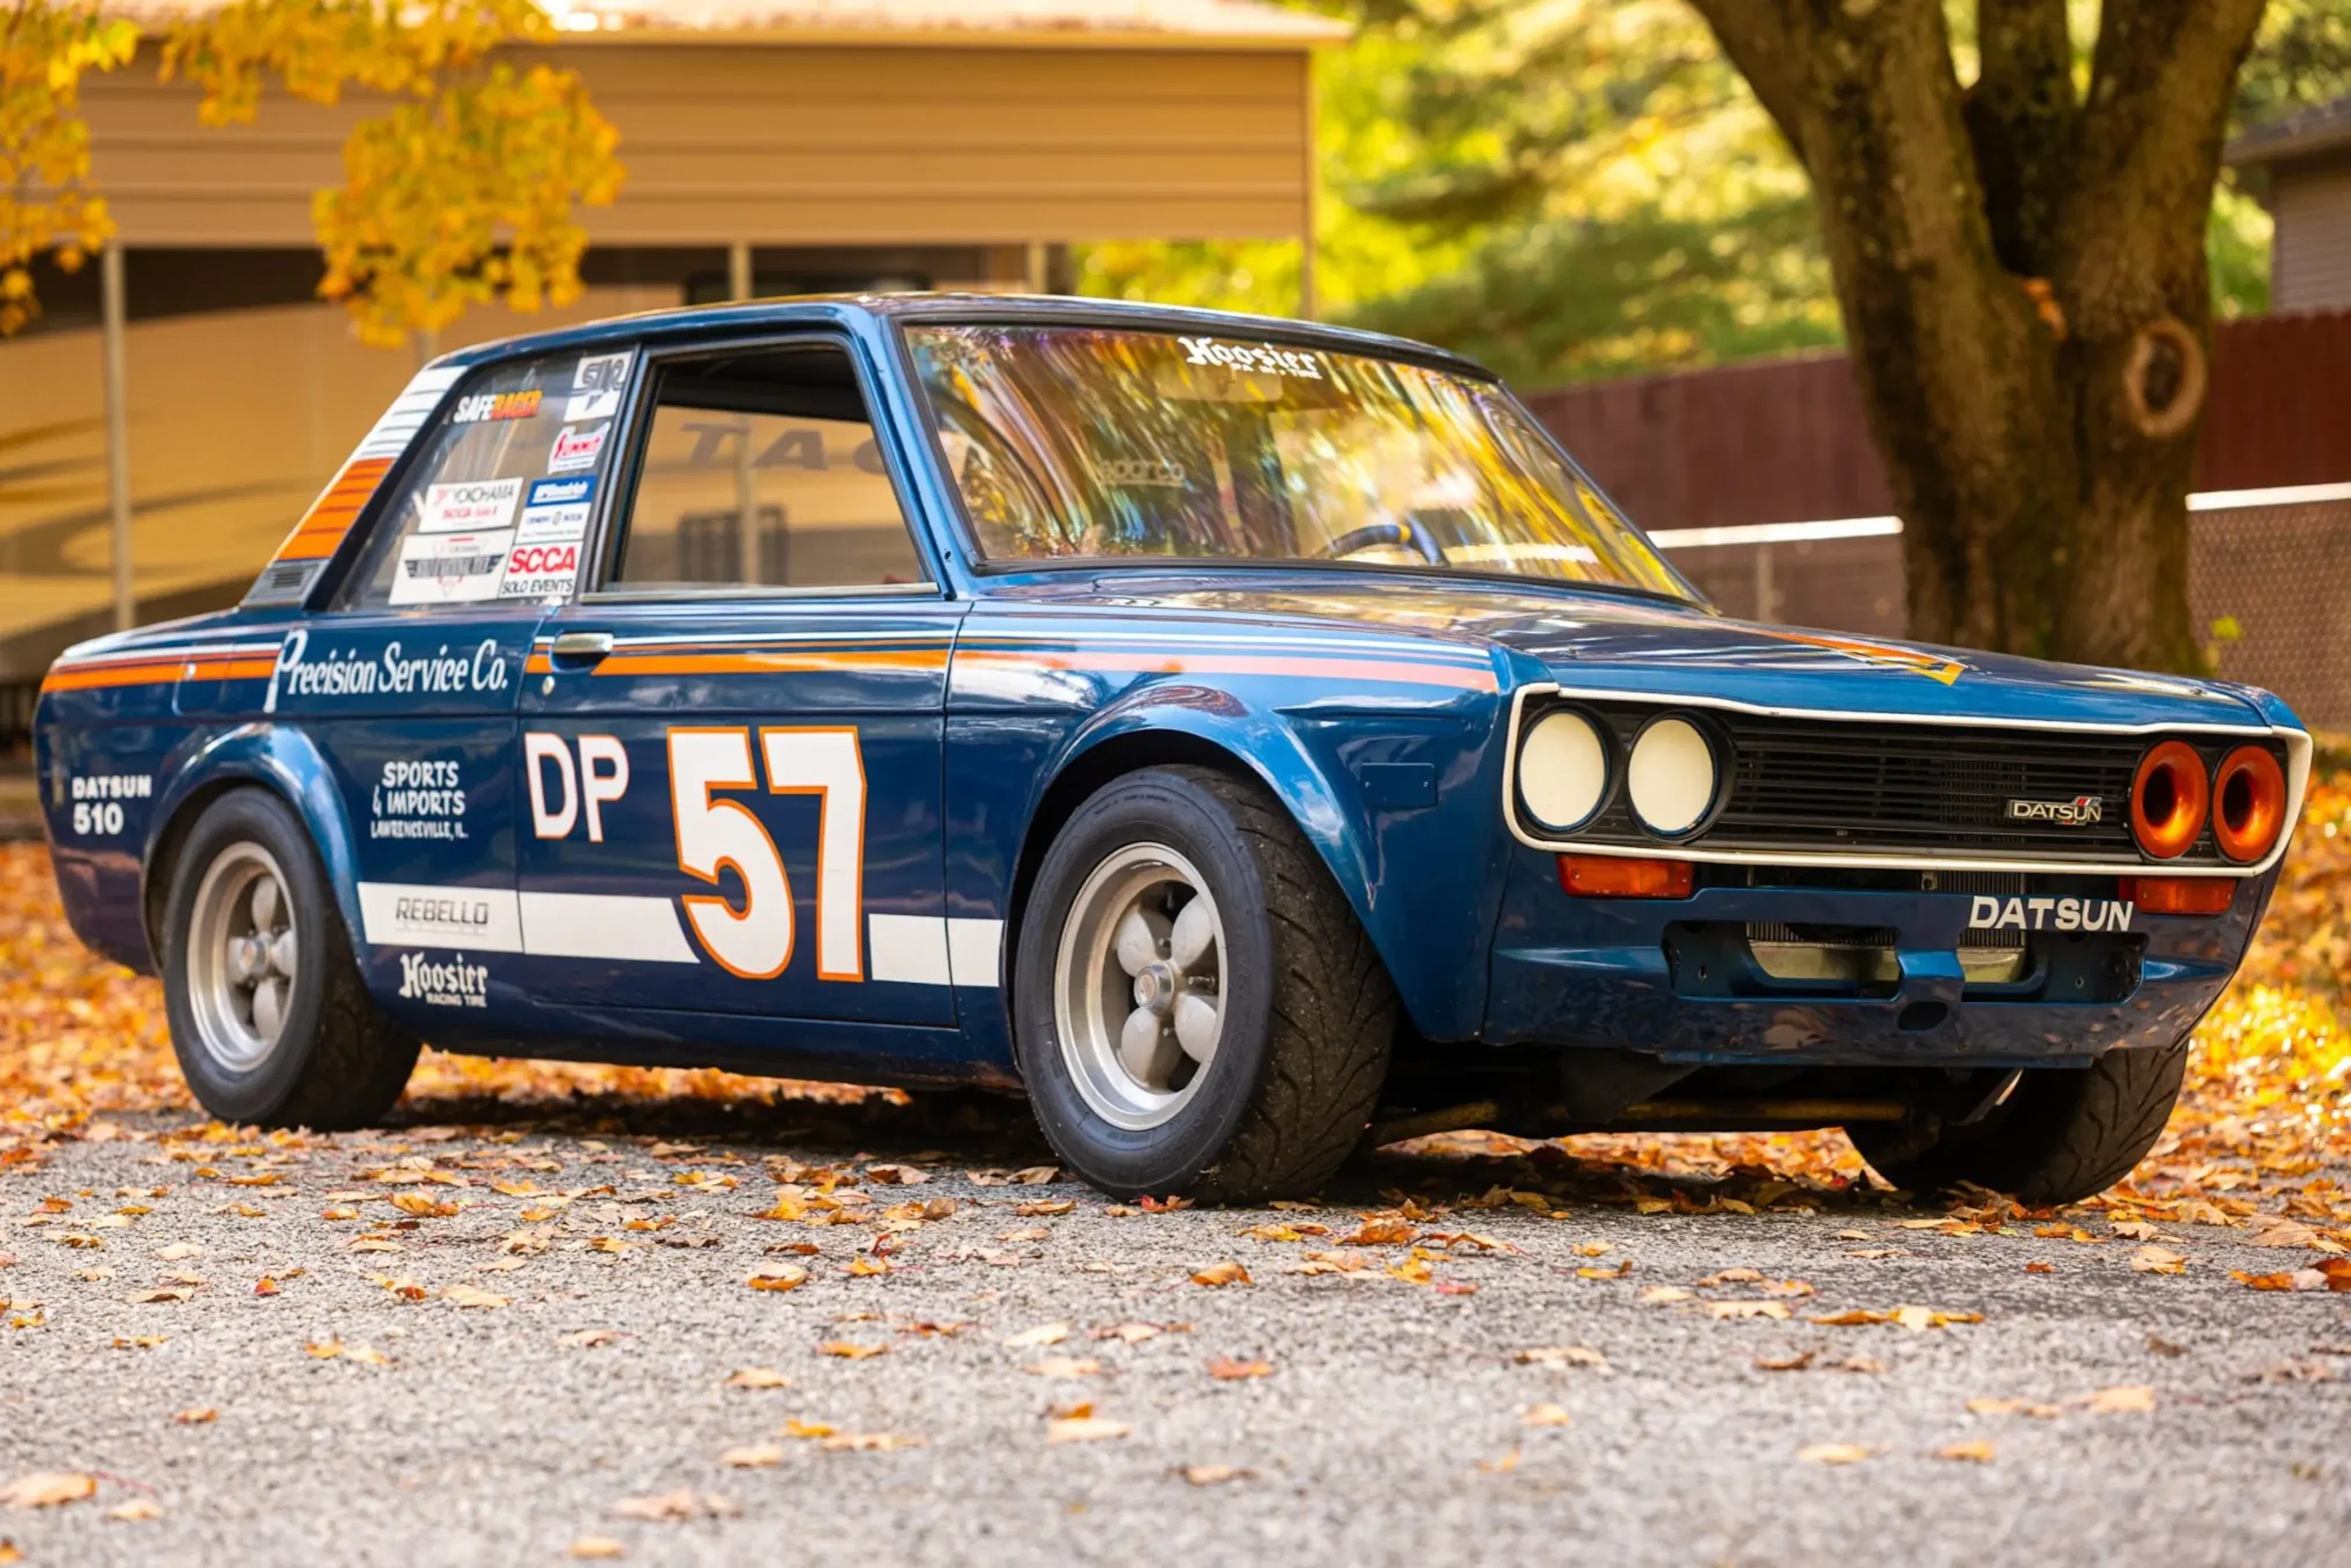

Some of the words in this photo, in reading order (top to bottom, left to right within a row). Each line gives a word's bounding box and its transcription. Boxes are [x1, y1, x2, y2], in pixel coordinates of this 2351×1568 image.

[1177, 336, 1317, 372] Hoosier
[509, 546, 576, 574] SCCA
[502, 580, 528, 595] SOLO
[530, 578, 574, 593] EVENTS
[263, 629, 377, 713] Precision
[378, 642, 467, 693] Service
[472, 639, 509, 691] Co.
[72, 775, 152, 798] DATSUN
[381, 760, 459, 788] SPORTS
[387, 790, 466, 816] IMPORTS
[2011, 800, 2101, 822] DATSUN
[73, 802, 123, 835] 510
[525, 732, 629, 842] DP
[667, 726, 868, 982] 57
[396, 898, 489, 924] REBELLO
[1968, 896, 2134, 932] DATSUN
[399, 951, 489, 999] Hoosier
